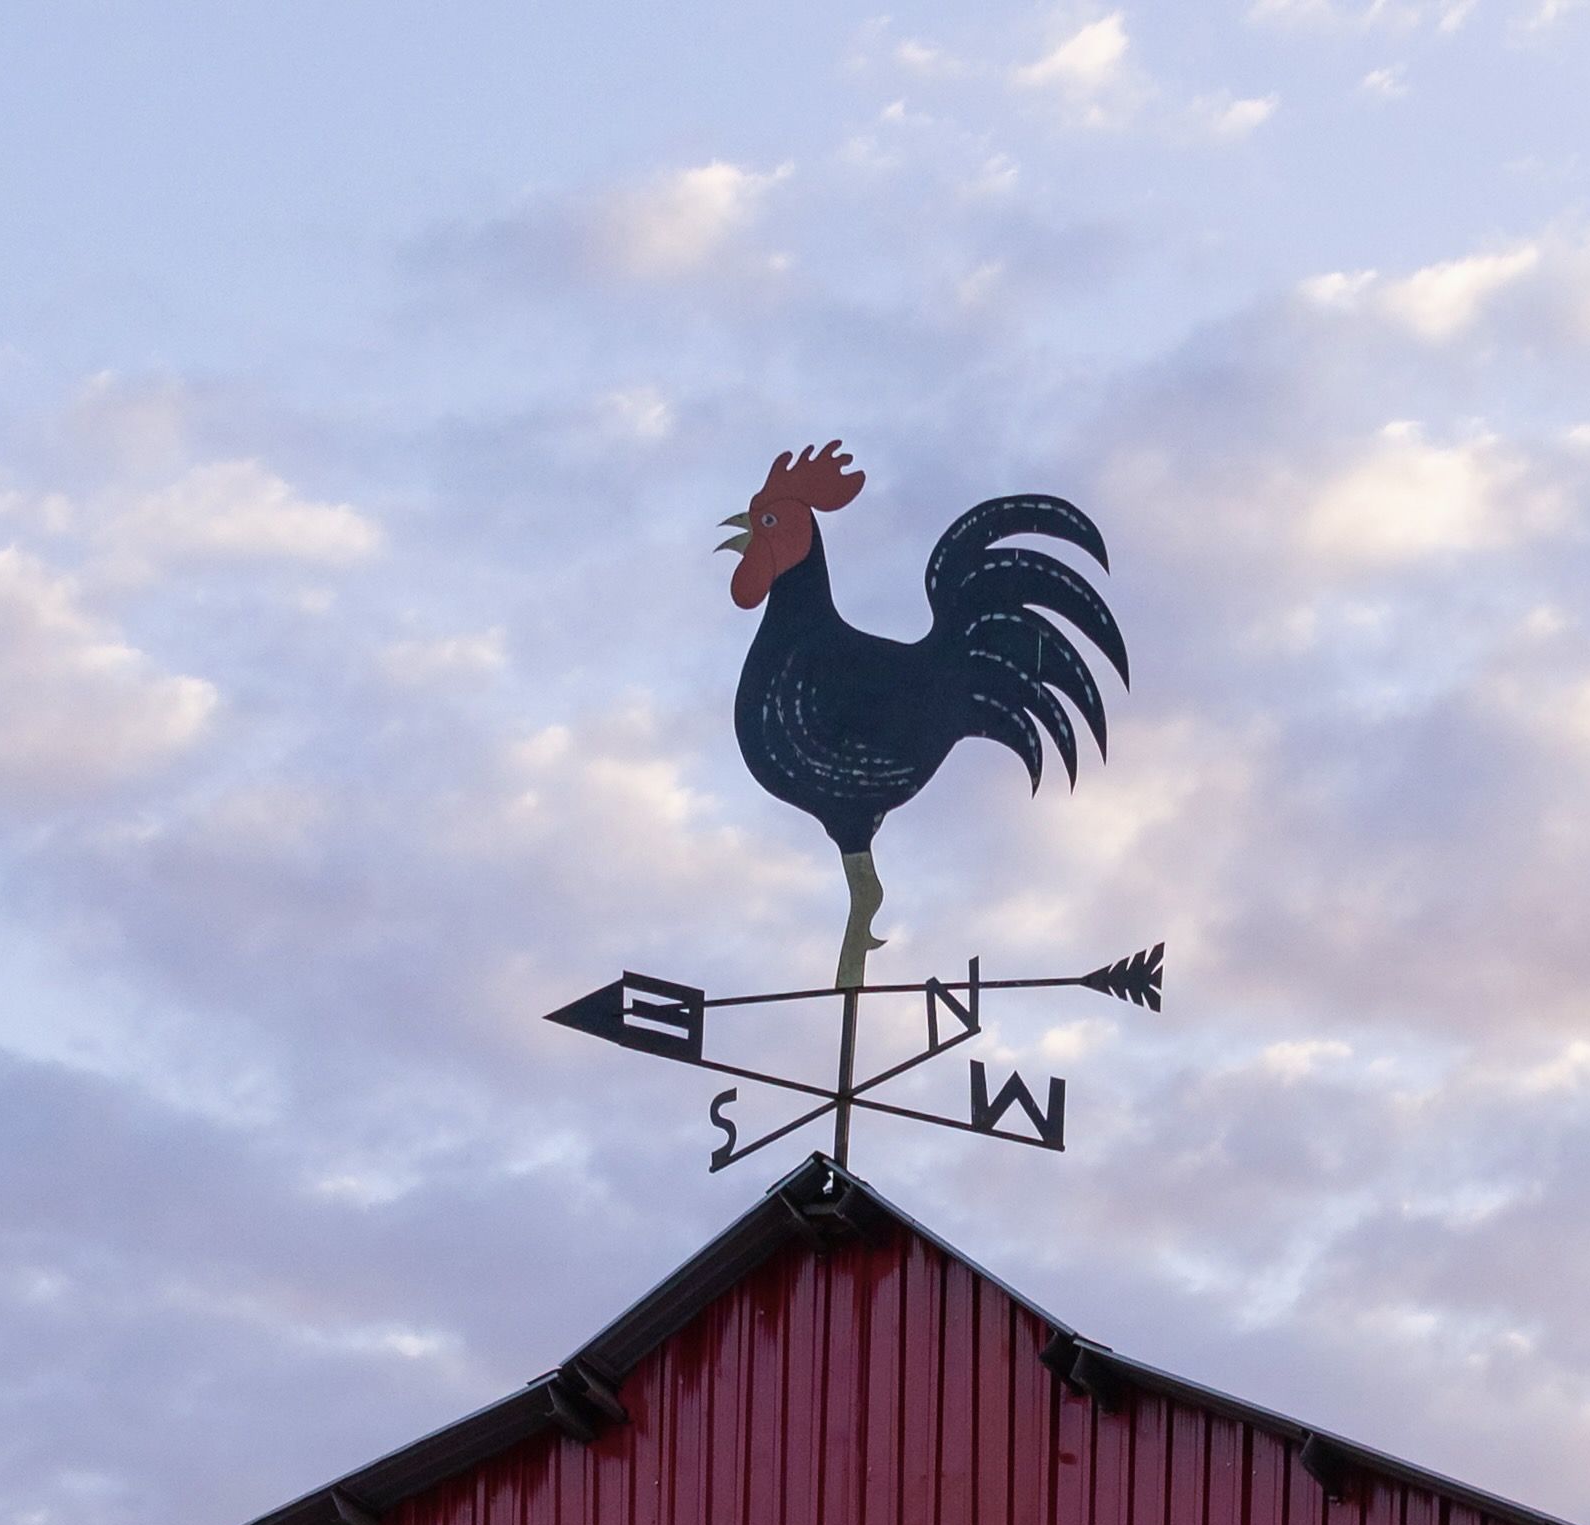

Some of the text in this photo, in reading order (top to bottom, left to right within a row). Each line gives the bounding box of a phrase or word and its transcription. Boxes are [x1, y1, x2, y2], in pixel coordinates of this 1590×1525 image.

[926, 955, 980, 1053] N
[709, 1086, 738, 1172] S
[969, 1058, 1066, 1151] W
